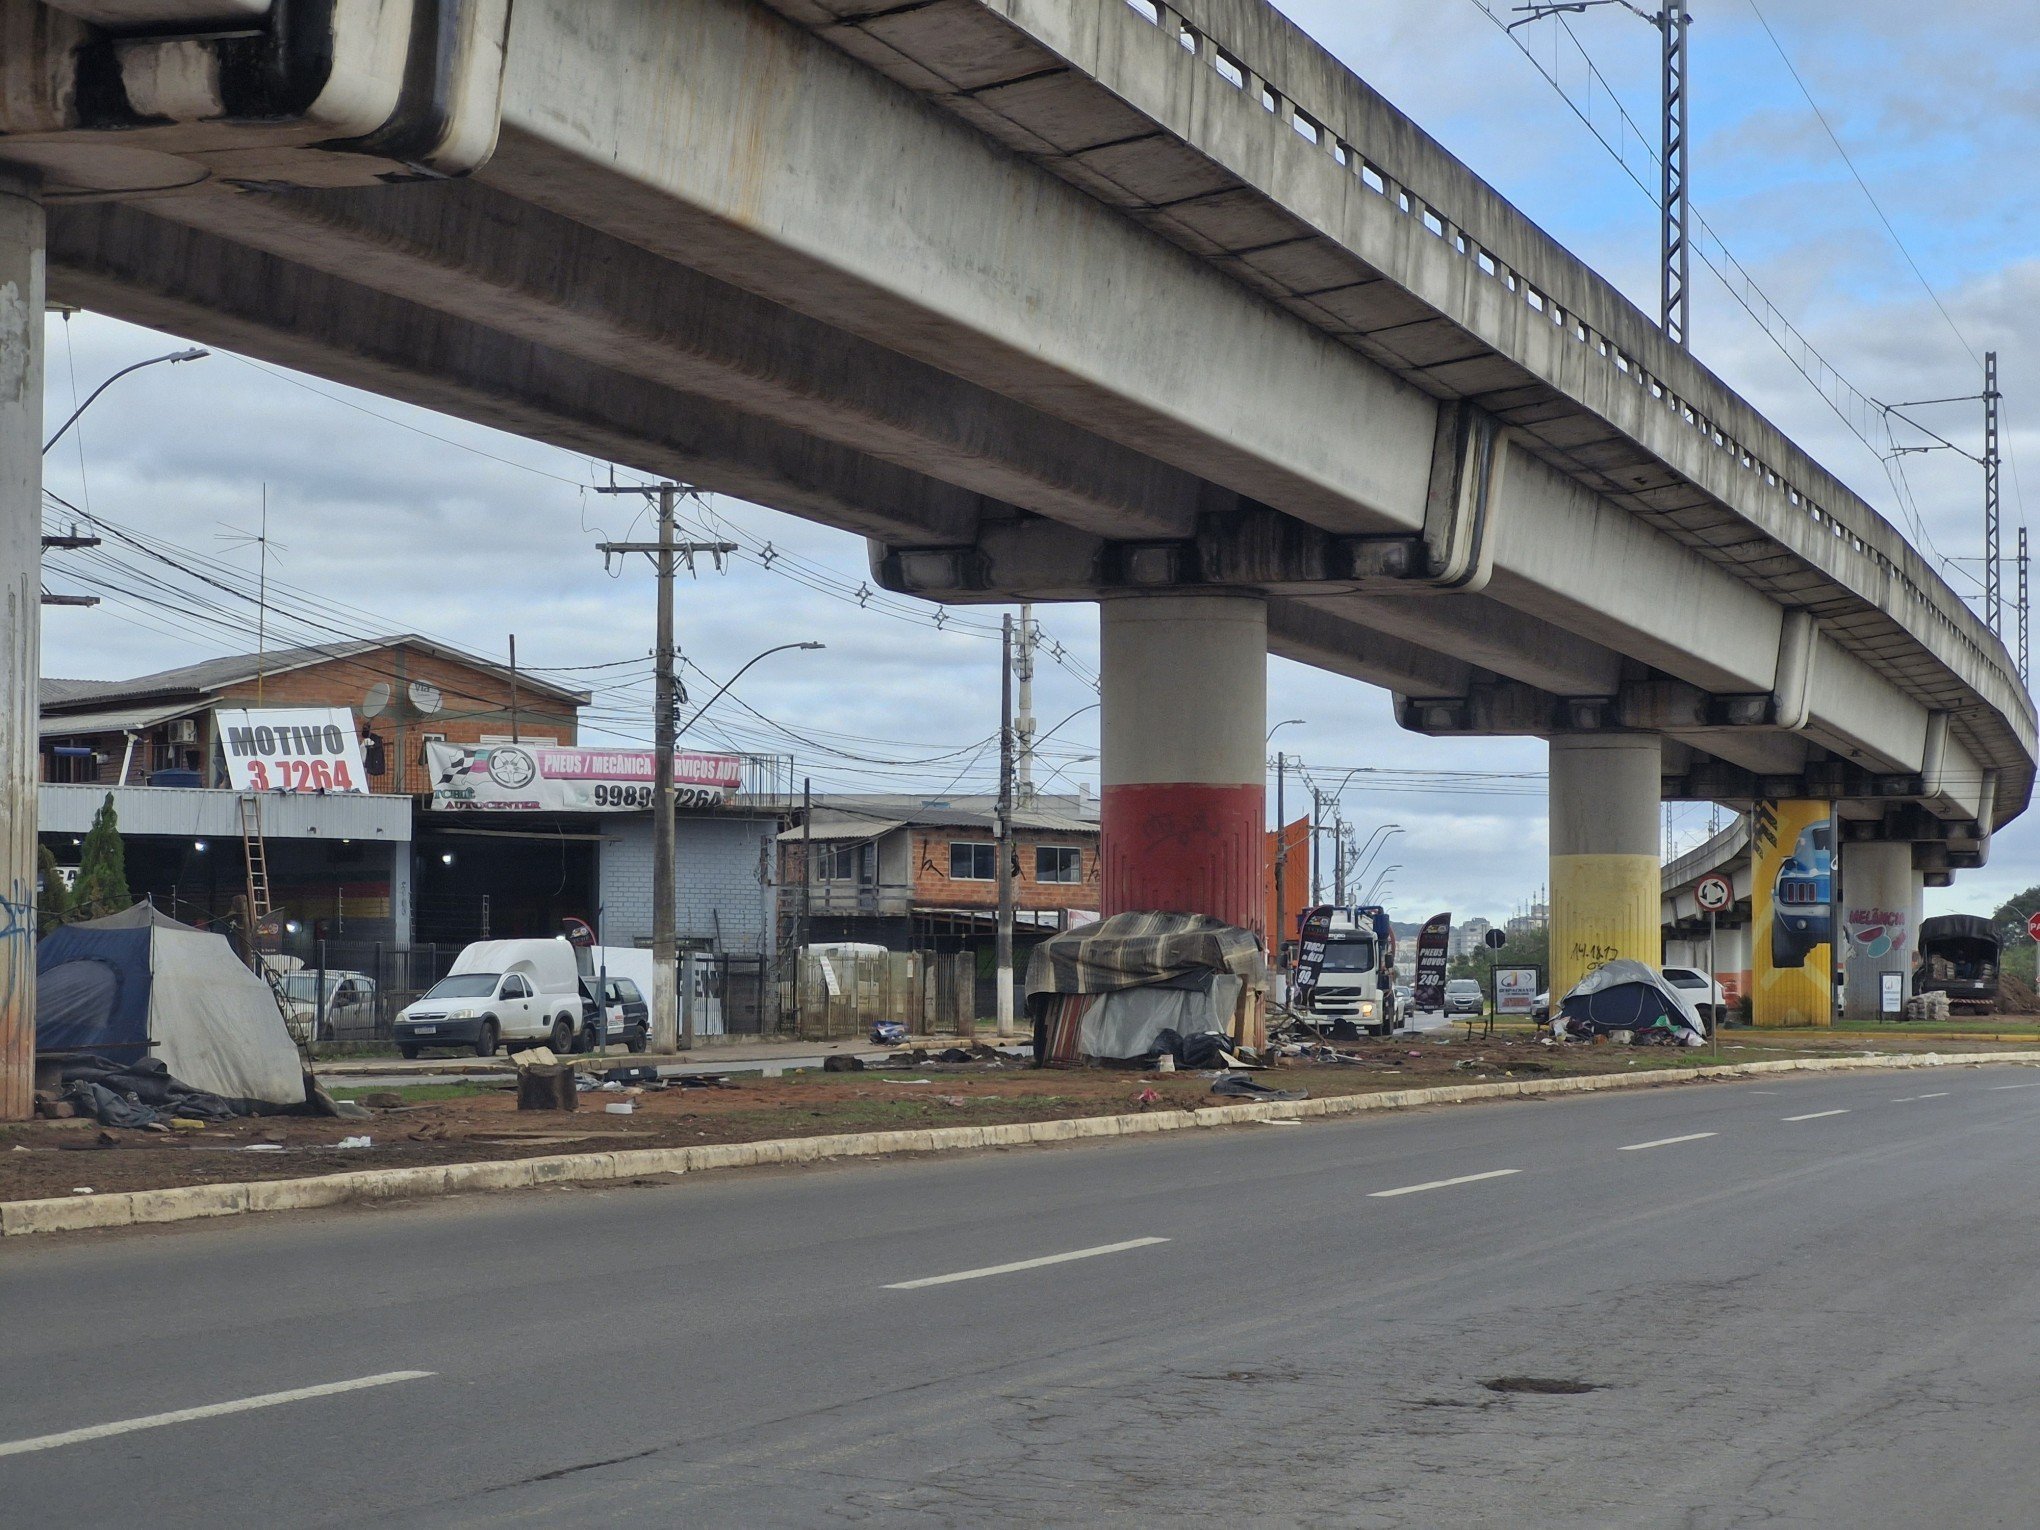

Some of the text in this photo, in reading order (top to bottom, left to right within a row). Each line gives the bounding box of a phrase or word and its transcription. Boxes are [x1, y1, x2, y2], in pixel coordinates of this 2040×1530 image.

[228, 725, 345, 756] MOTIVO
[544, 754, 582, 773] PNEUS
[592, 754, 651, 775] MECÂNICA
[674, 758, 716, 781] RVIÇOS
[247, 760, 353, 791] 3 7264
[594, 784, 722, 808] 99897264
[444, 801, 541, 809] AUTOCENTER
[1303, 941, 1325, 952] TROCA
[1419, 948, 1444, 956] PNEUS
[1421, 957, 1446, 966] NOVOS
[1298, 970, 1312, 984] 99
[1418, 974, 1440, 986] 249
